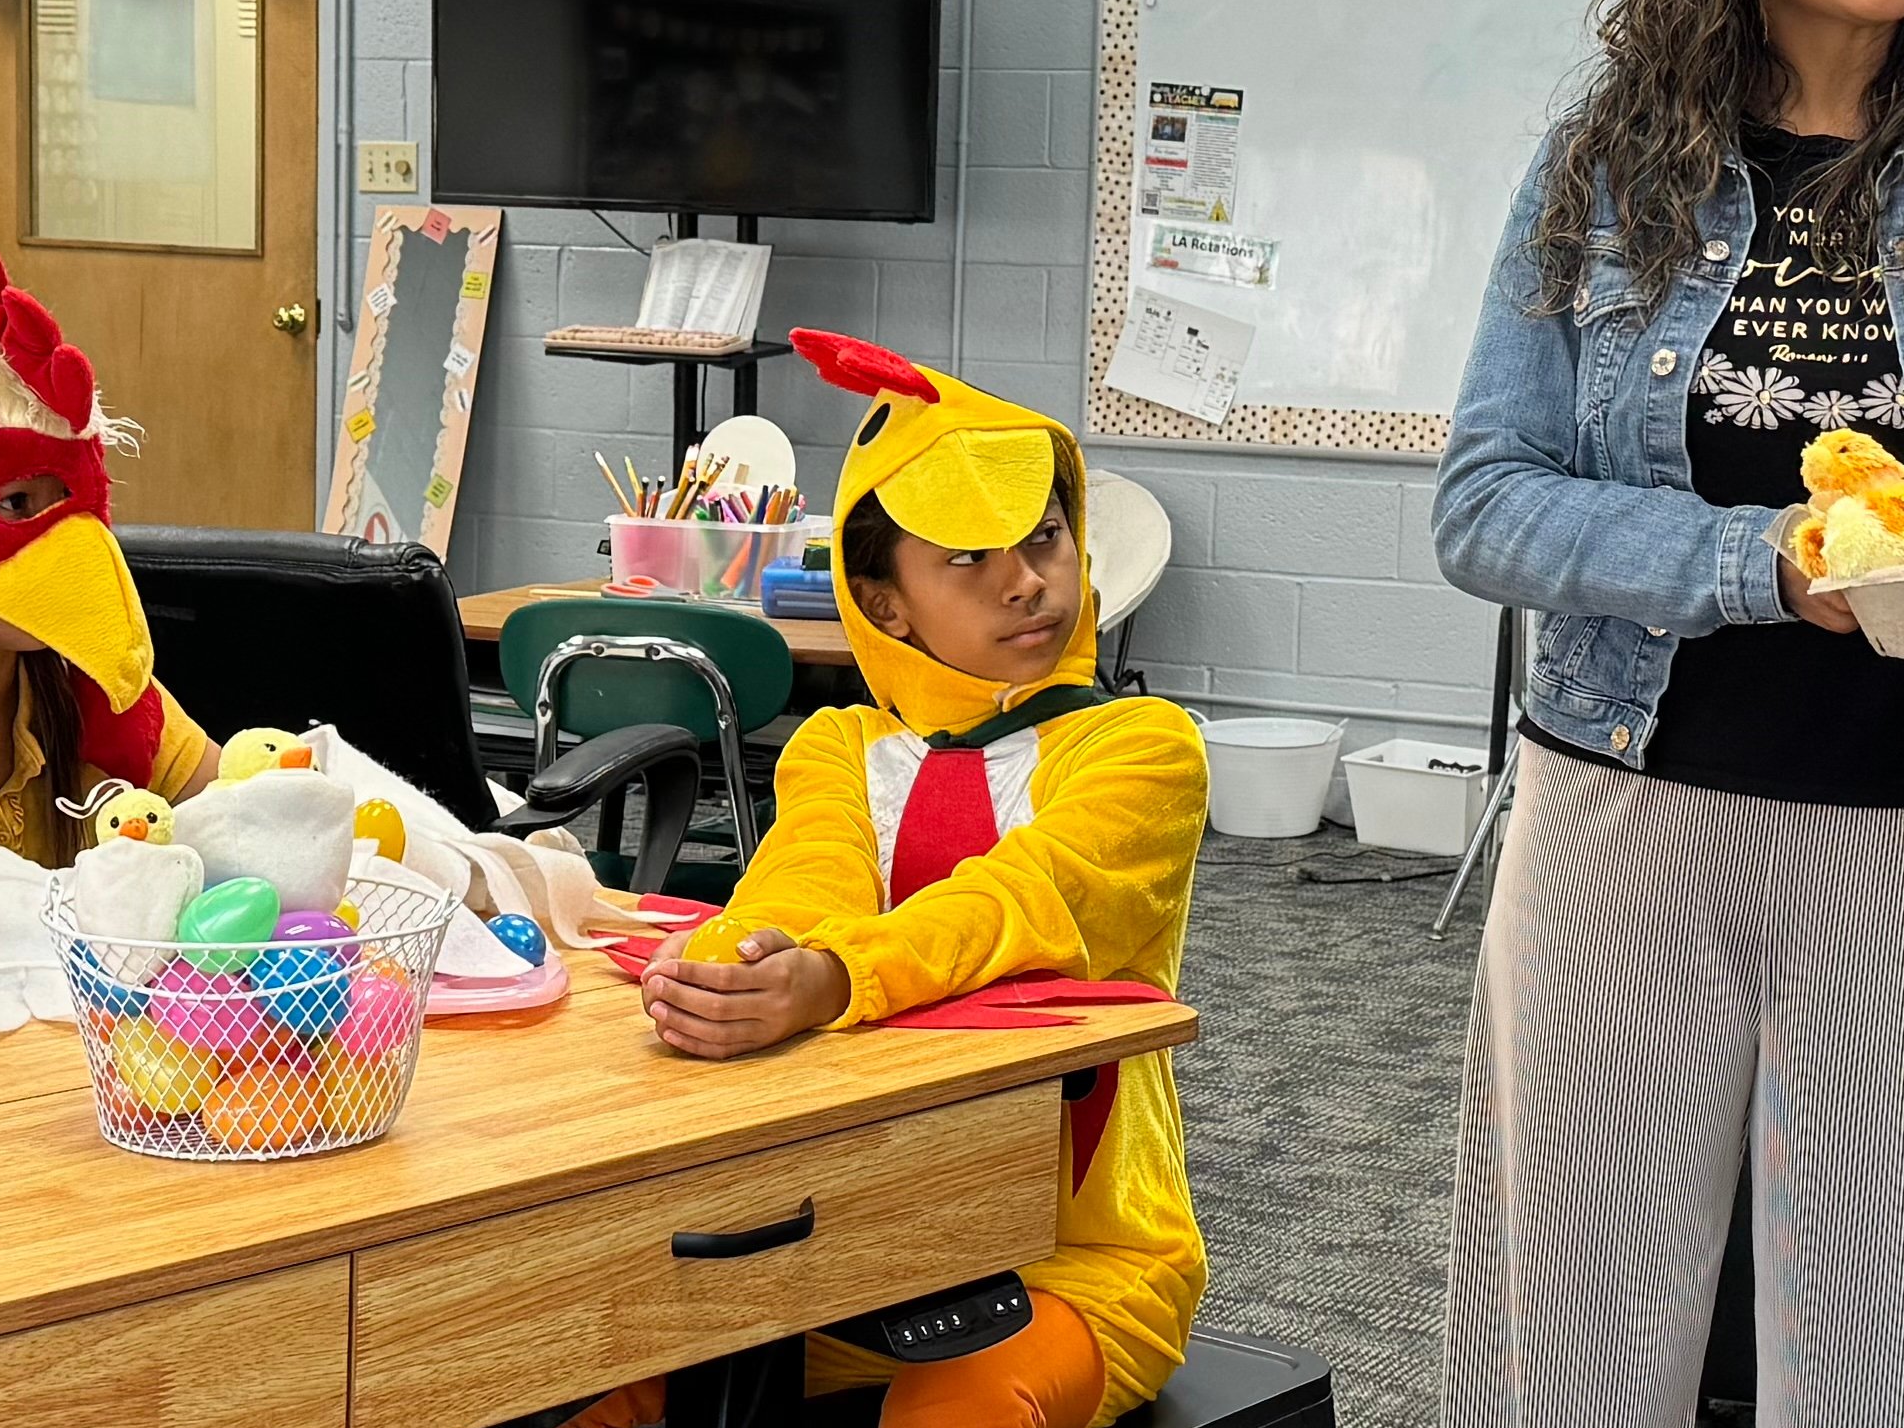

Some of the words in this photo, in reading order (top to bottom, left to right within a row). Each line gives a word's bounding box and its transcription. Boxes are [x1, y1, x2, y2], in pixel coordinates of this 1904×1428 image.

[1171, 235, 1187, 250] LA
[1191, 234, 1254, 259] Rotations
[1729, 296, 1787, 314] HAN
[1796, 297, 1851, 316] YOU
[1733, 319, 1808, 340] EVER
[921, 1325, 928, 1335] 1
[936, 1320, 944, 1330] 2
[952, 1314, 960, 1325] 3
